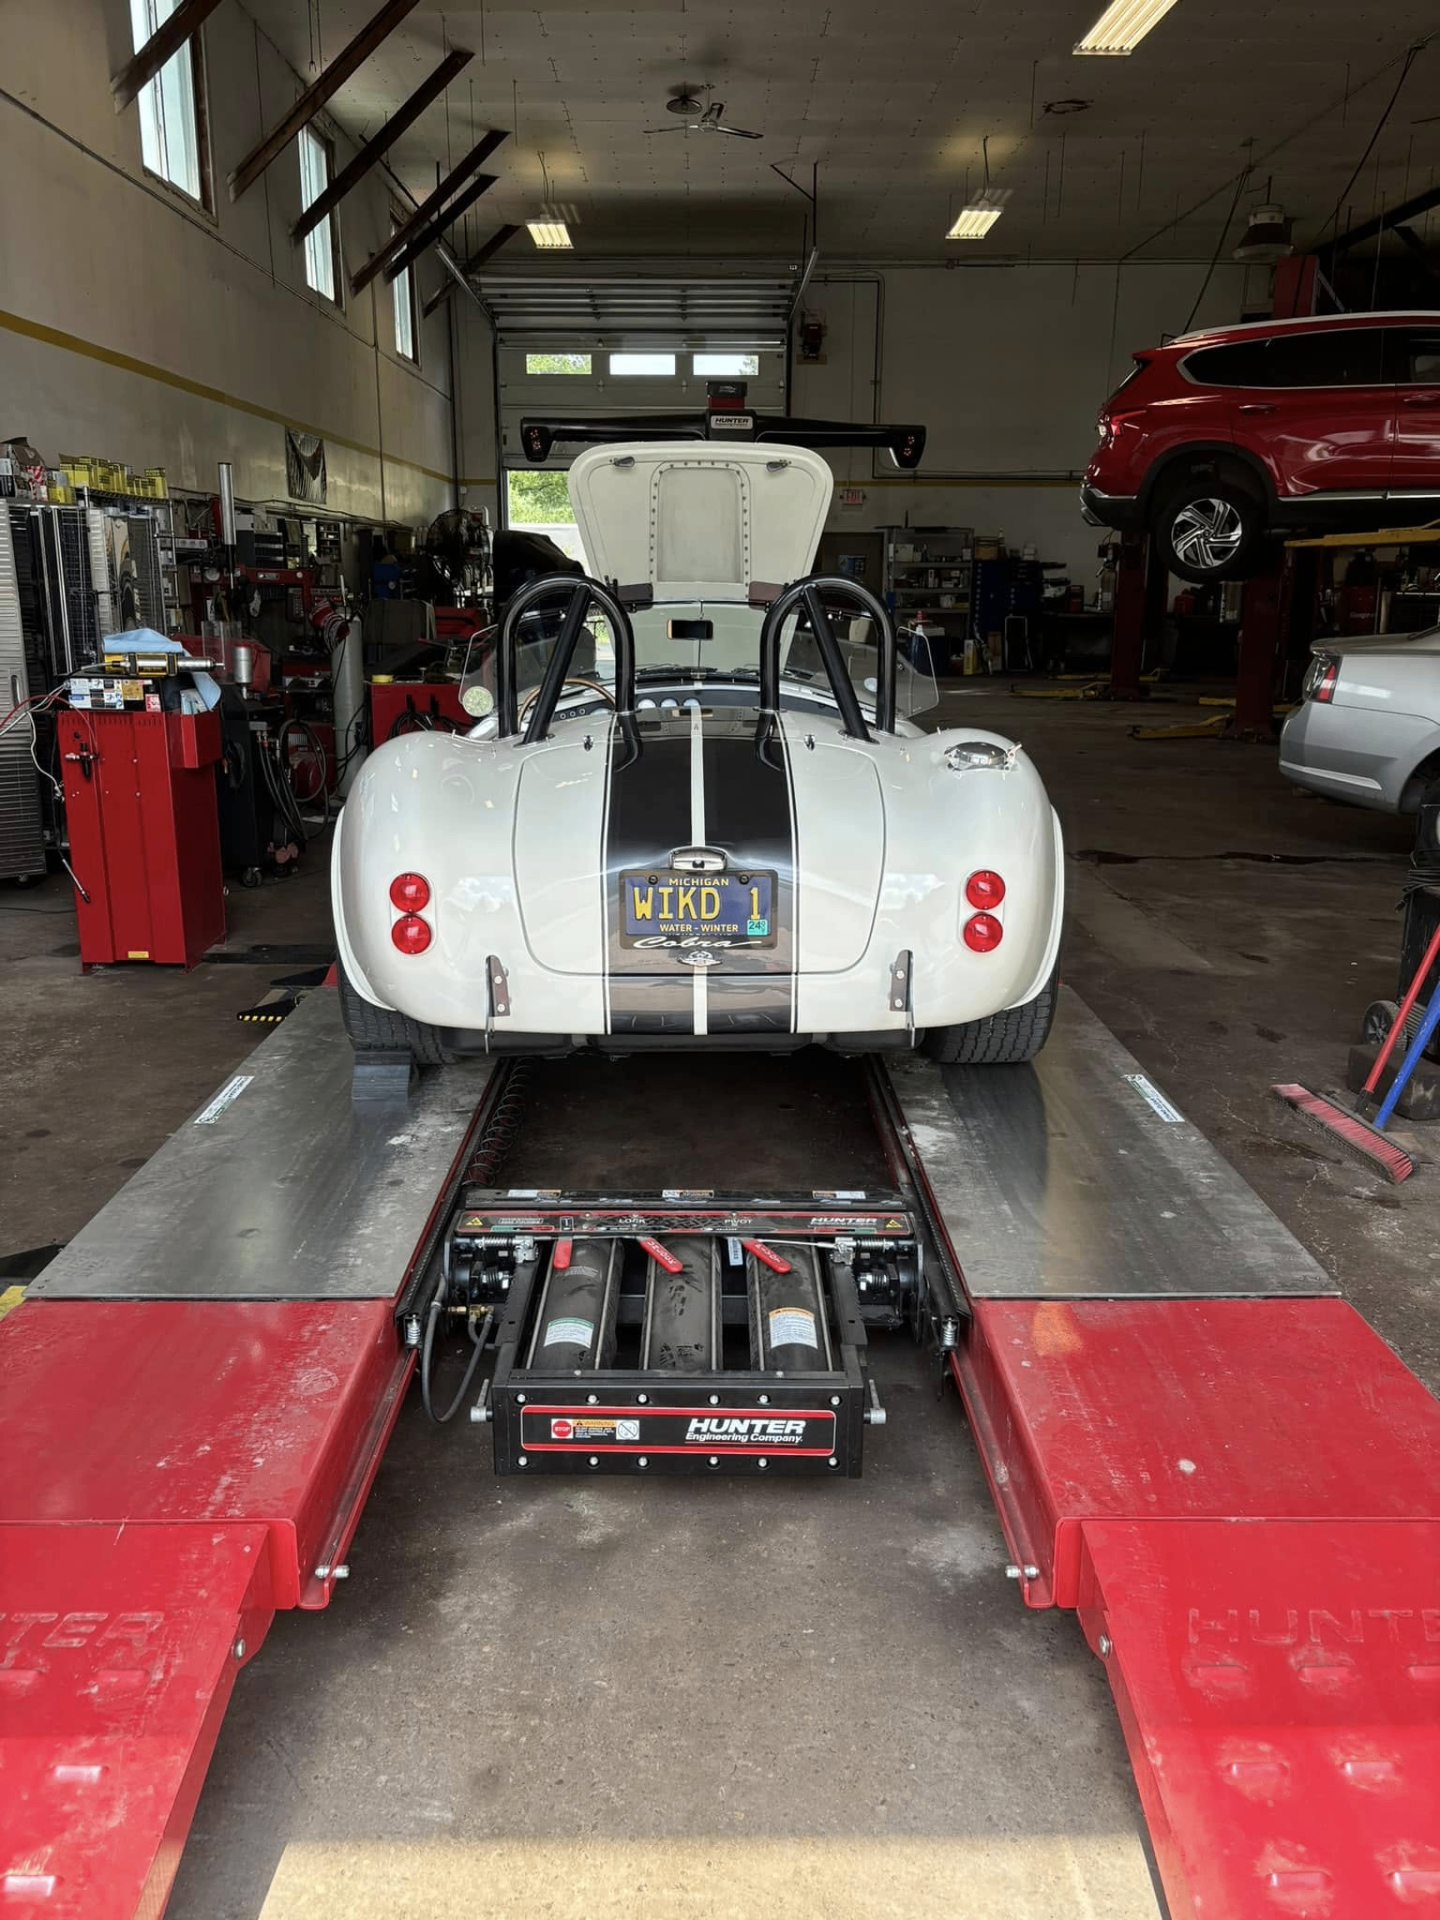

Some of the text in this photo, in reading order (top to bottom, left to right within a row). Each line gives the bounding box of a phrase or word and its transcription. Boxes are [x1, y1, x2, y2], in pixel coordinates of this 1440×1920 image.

[668, 878, 729, 886] MICHIGAN
[633, 886, 760, 920] WIKD 1
[633, 936, 762, 949] Cobra
[687, 1418, 807, 1434] HUNTER
[685, 1431, 749, 1443] Engineering
[0, 1612, 165, 1648] TER
